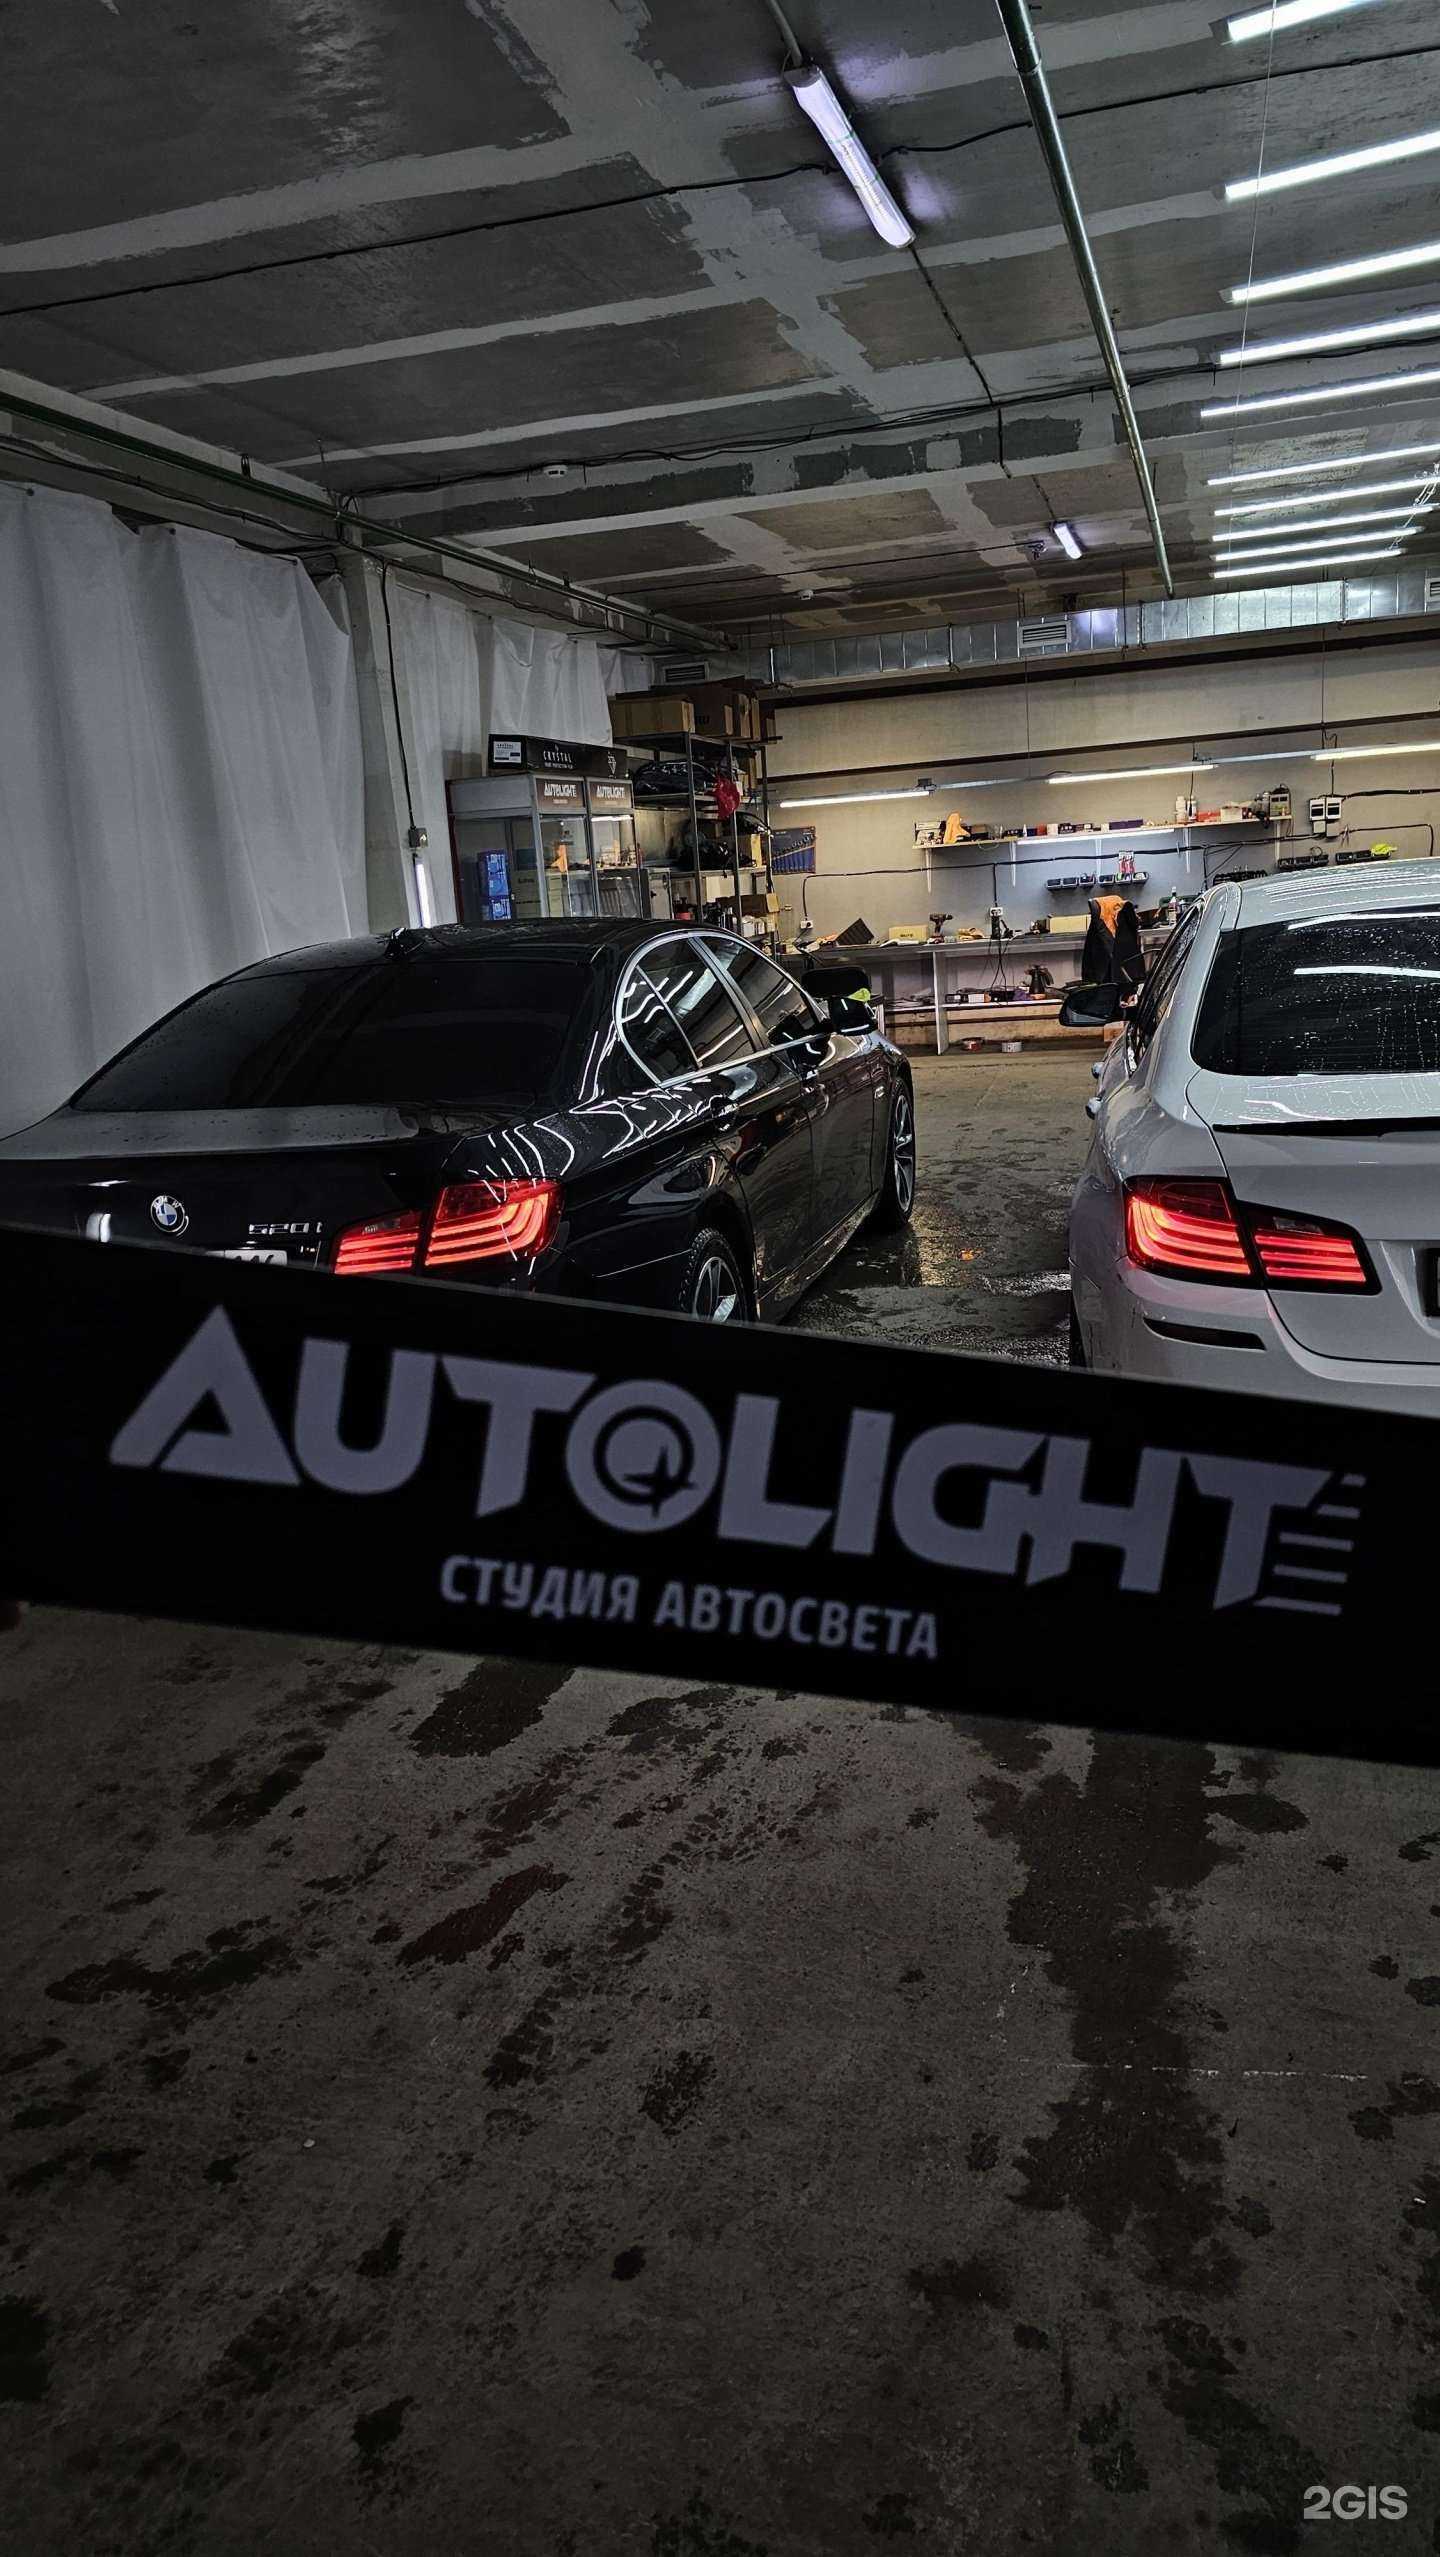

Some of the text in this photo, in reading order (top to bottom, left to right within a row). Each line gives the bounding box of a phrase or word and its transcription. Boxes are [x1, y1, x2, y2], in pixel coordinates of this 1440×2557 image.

[543, 750, 572, 763] CRYSTAL
[543, 781, 577, 798] AUTOLIGHT
[596, 784, 625, 799] AUTOLIGHT
[110, 1306, 1364, 1614] AUTOLIGHT
[440, 1554, 938, 1659] СТУДИЯ АВТОСВЕТА
